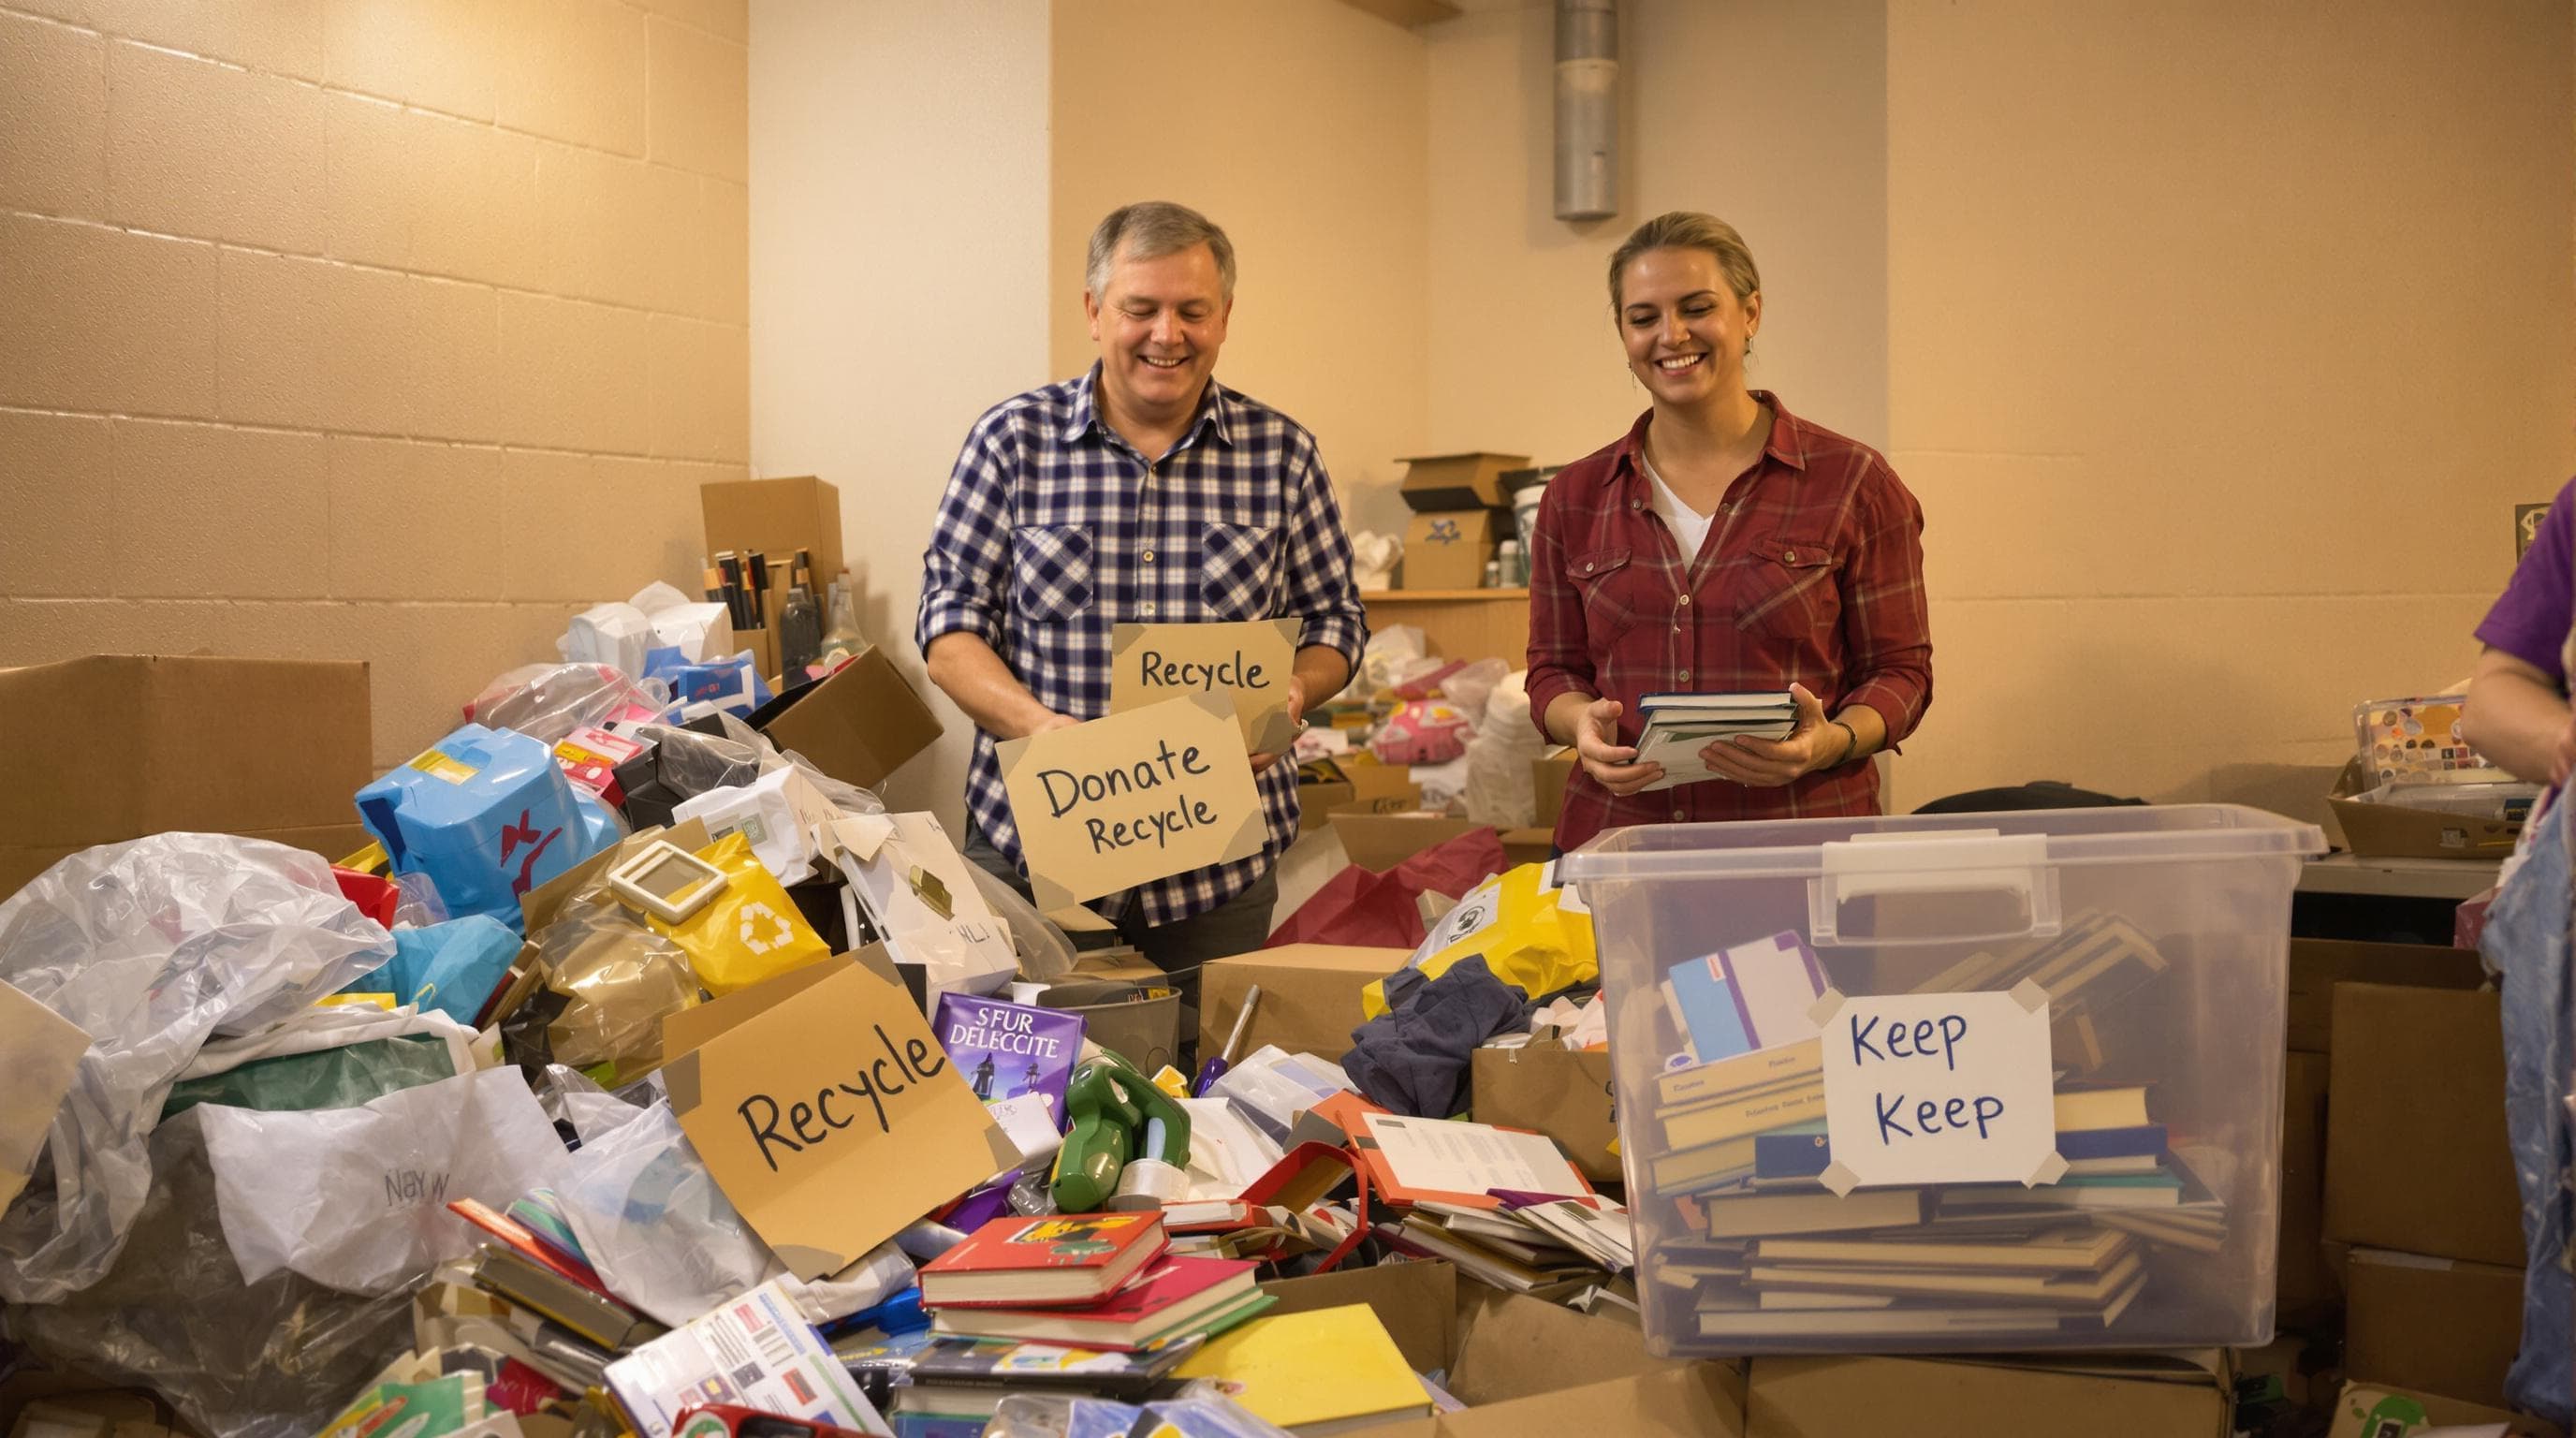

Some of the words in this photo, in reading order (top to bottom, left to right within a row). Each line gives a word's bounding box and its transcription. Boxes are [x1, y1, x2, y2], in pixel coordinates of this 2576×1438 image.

[1141, 650, 1270, 692] Recycle
[1036, 739, 1211, 819] Donate
[1085, 793, 1218, 854] Recycle
[1851, 1012, 1968, 1072] Keep
[738, 1024, 946, 1172] Recycle
[1875, 1092, 2006, 1147] Keep
